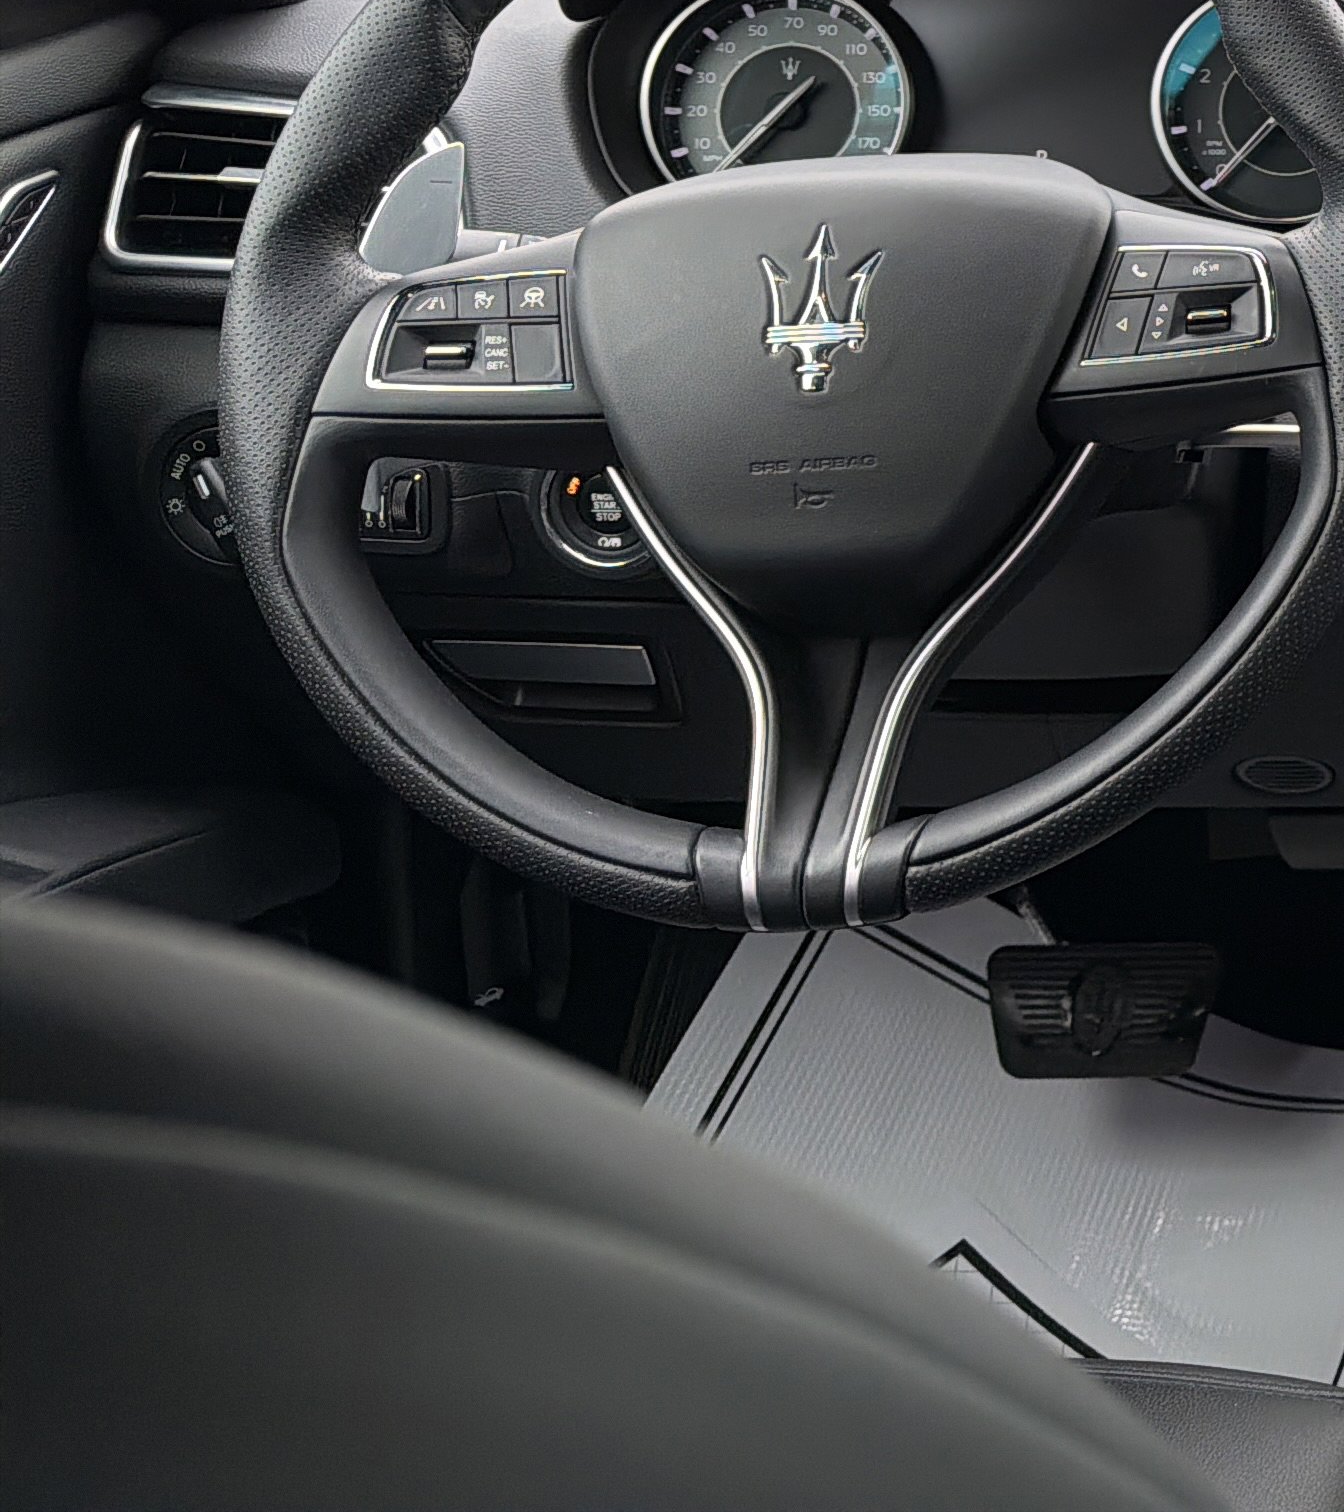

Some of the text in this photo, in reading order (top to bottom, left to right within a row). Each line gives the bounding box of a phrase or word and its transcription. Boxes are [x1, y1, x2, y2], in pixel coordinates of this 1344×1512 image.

[783, 16, 805, 29] 70
[747, 25, 768, 37] 50
[817, 24, 839, 37] 90
[715, 41, 736, 54] 40
[845, 43, 868, 56] 110
[695, 71, 717, 84] 30
[862, 71, 887, 84] 130
[1200, 69, 1212, 84] 2
[686, 104, 708, 117] 20
[867, 105, 892, 117] 150
[693, 138, 711, 150] 10
[857, 137, 881, 149] 170
[484, 336, 509, 346] RES+
[484, 348, 509, 358] CANC
[170, 452, 191, 481] AUTO
[798, 454, 878, 474] AIRBAG
[596, 512, 622, 522] STOP
